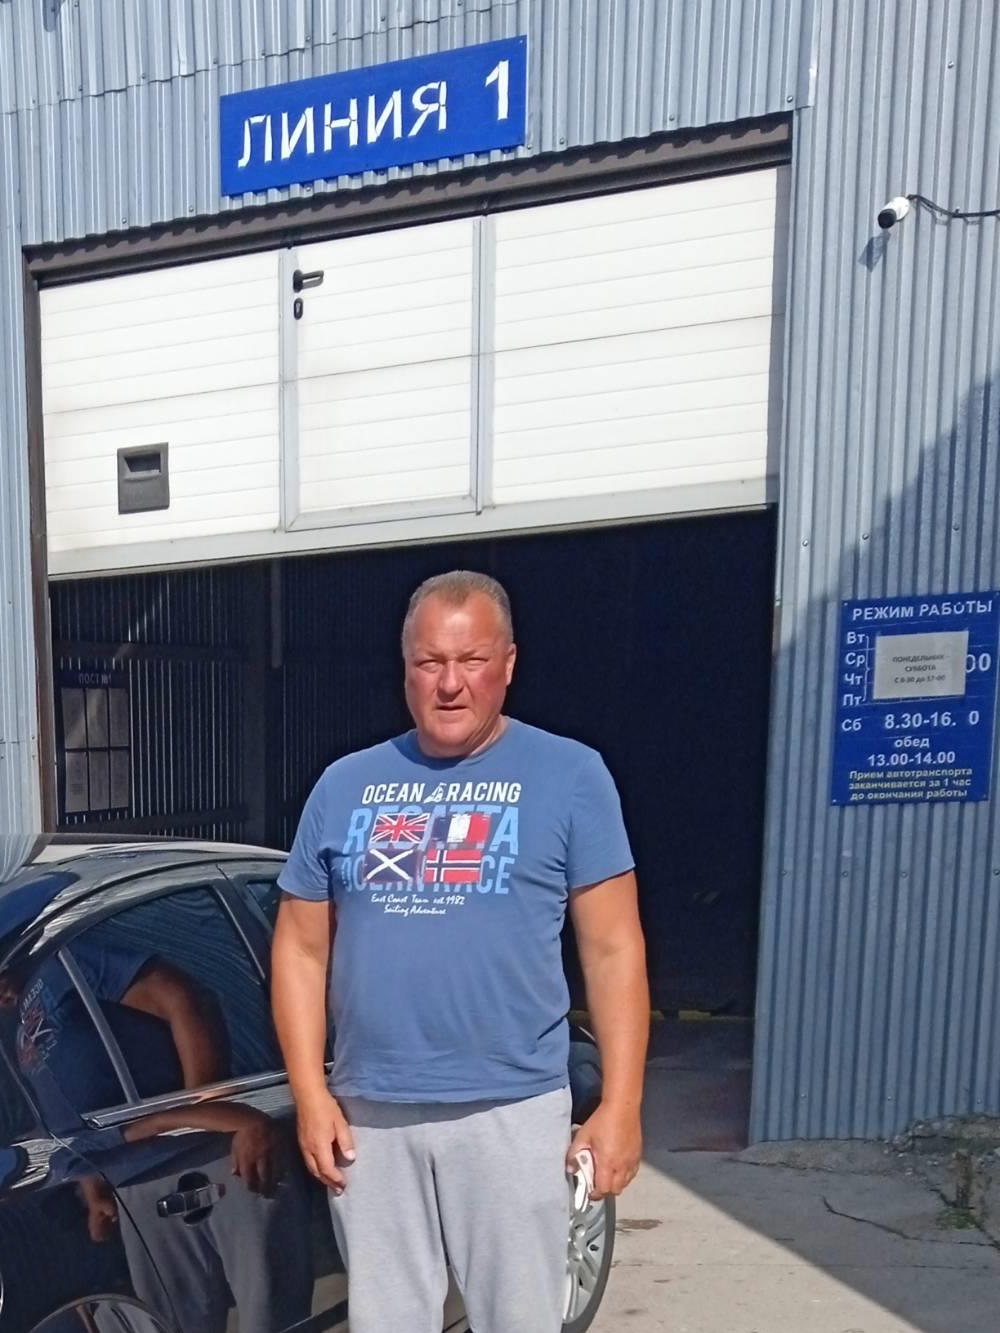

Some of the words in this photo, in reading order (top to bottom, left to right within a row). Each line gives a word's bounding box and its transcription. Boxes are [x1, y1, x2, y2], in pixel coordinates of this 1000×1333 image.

[238, 81, 447, 168] ЛИНИЯ
[485, 60, 509, 120] 1
[852, 606, 914, 621] РЕЖИМ
[919, 600, 993, 617] РАБОТЫ
[846, 631, 866, 644] Вт
[845, 652, 866, 667] Ср
[844, 673, 864, 685] Чт
[842, 694, 861, 706] Пт
[841, 718, 863, 732] Сб
[894, 735, 930, 749] обед
[867, 751, 957, 767] 13.00-14.00
[849, 770, 884, 780] Прием
[886, 768, 973, 779] автотранспорта
[952, 779, 972, 787] час
[361, 783, 425, 805] OCEAN
[445, 782, 522, 803] RACING
[850, 791, 865, 801] до
[926, 788, 968, 799] работы
